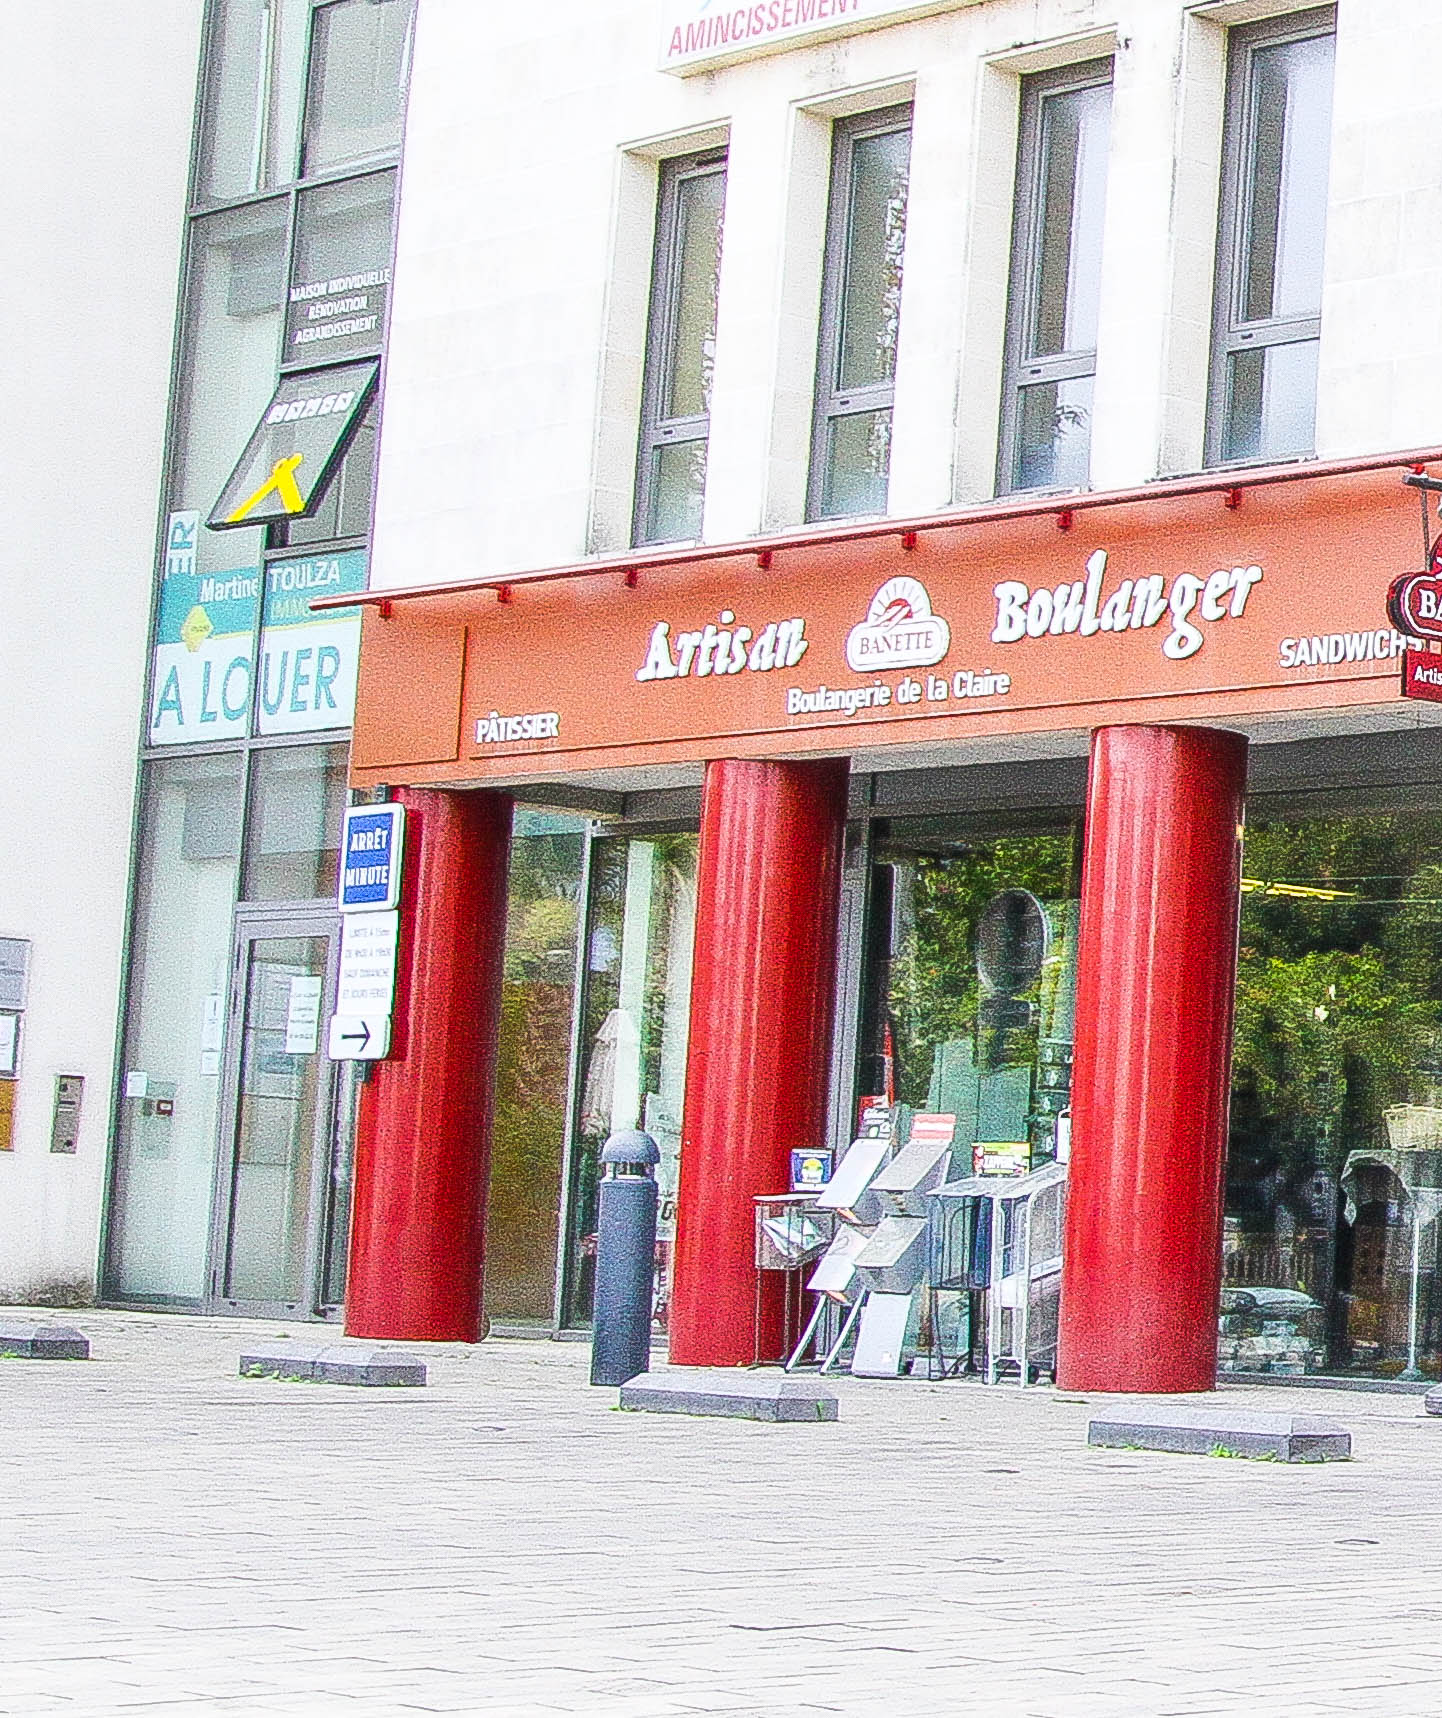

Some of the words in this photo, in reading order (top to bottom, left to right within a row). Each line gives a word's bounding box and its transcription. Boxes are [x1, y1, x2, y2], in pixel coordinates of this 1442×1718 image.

[293, 315, 379, 345] AGRANDISSEMENT
[270, 560, 340, 592] TOULZA
[990, 549, 1263, 660] Boulanger
[636, 609, 808, 683] Artisan
[858, 628, 934, 657] BANETTE
[200, 645, 341, 723] LOUER
[787, 682, 892, 716] Boulangerie
[898, 677, 920, 702] de
[927, 675, 947, 700] la
[953, 670, 1010, 699] Claire
[474, 710, 560, 744] PÂTISSIER
[350, 828, 387, 852] ARRÊT
[345, 866, 389, 887] MINUTE
